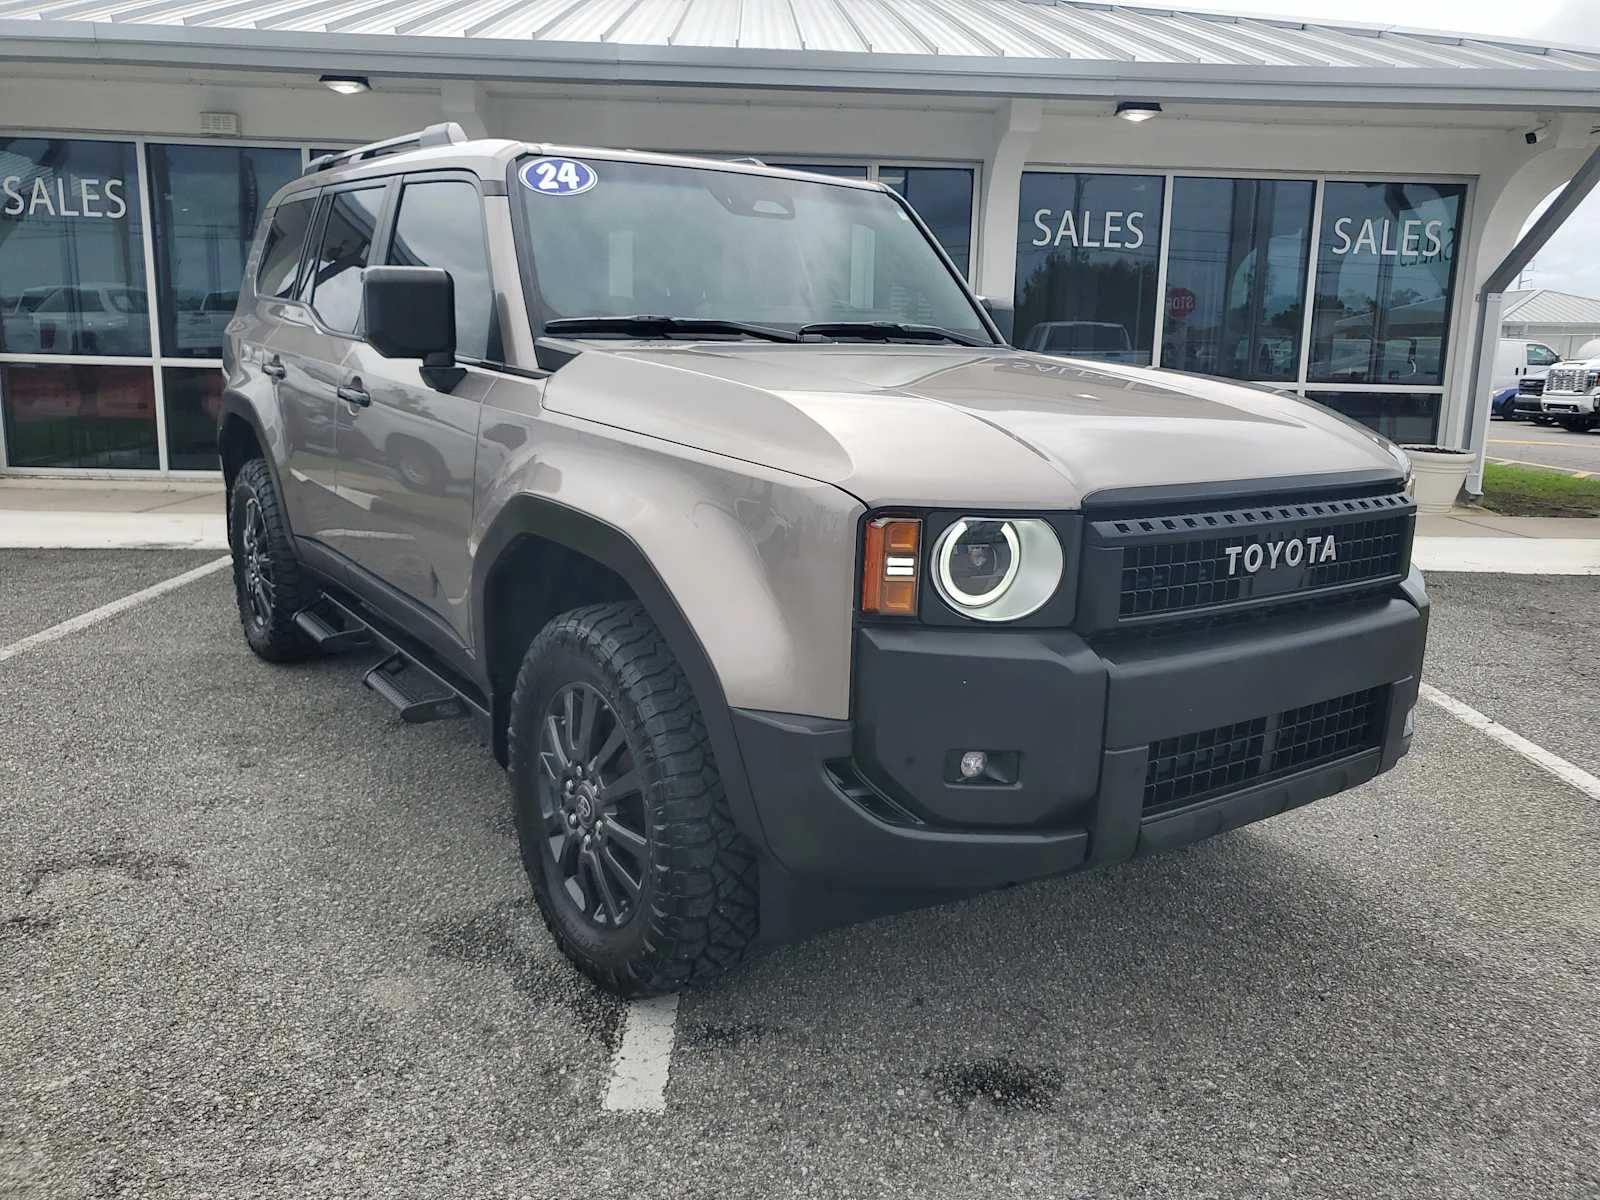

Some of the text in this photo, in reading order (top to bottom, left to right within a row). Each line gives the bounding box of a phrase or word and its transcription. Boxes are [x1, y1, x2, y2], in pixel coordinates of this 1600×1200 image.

[536, 162, 580, 190] 24
[3, 175, 127, 219] SALES
[1032, 208, 1144, 249] SALES
[1332, 217, 1442, 257] SALES
[1225, 534, 1337, 575] TOYOTA
